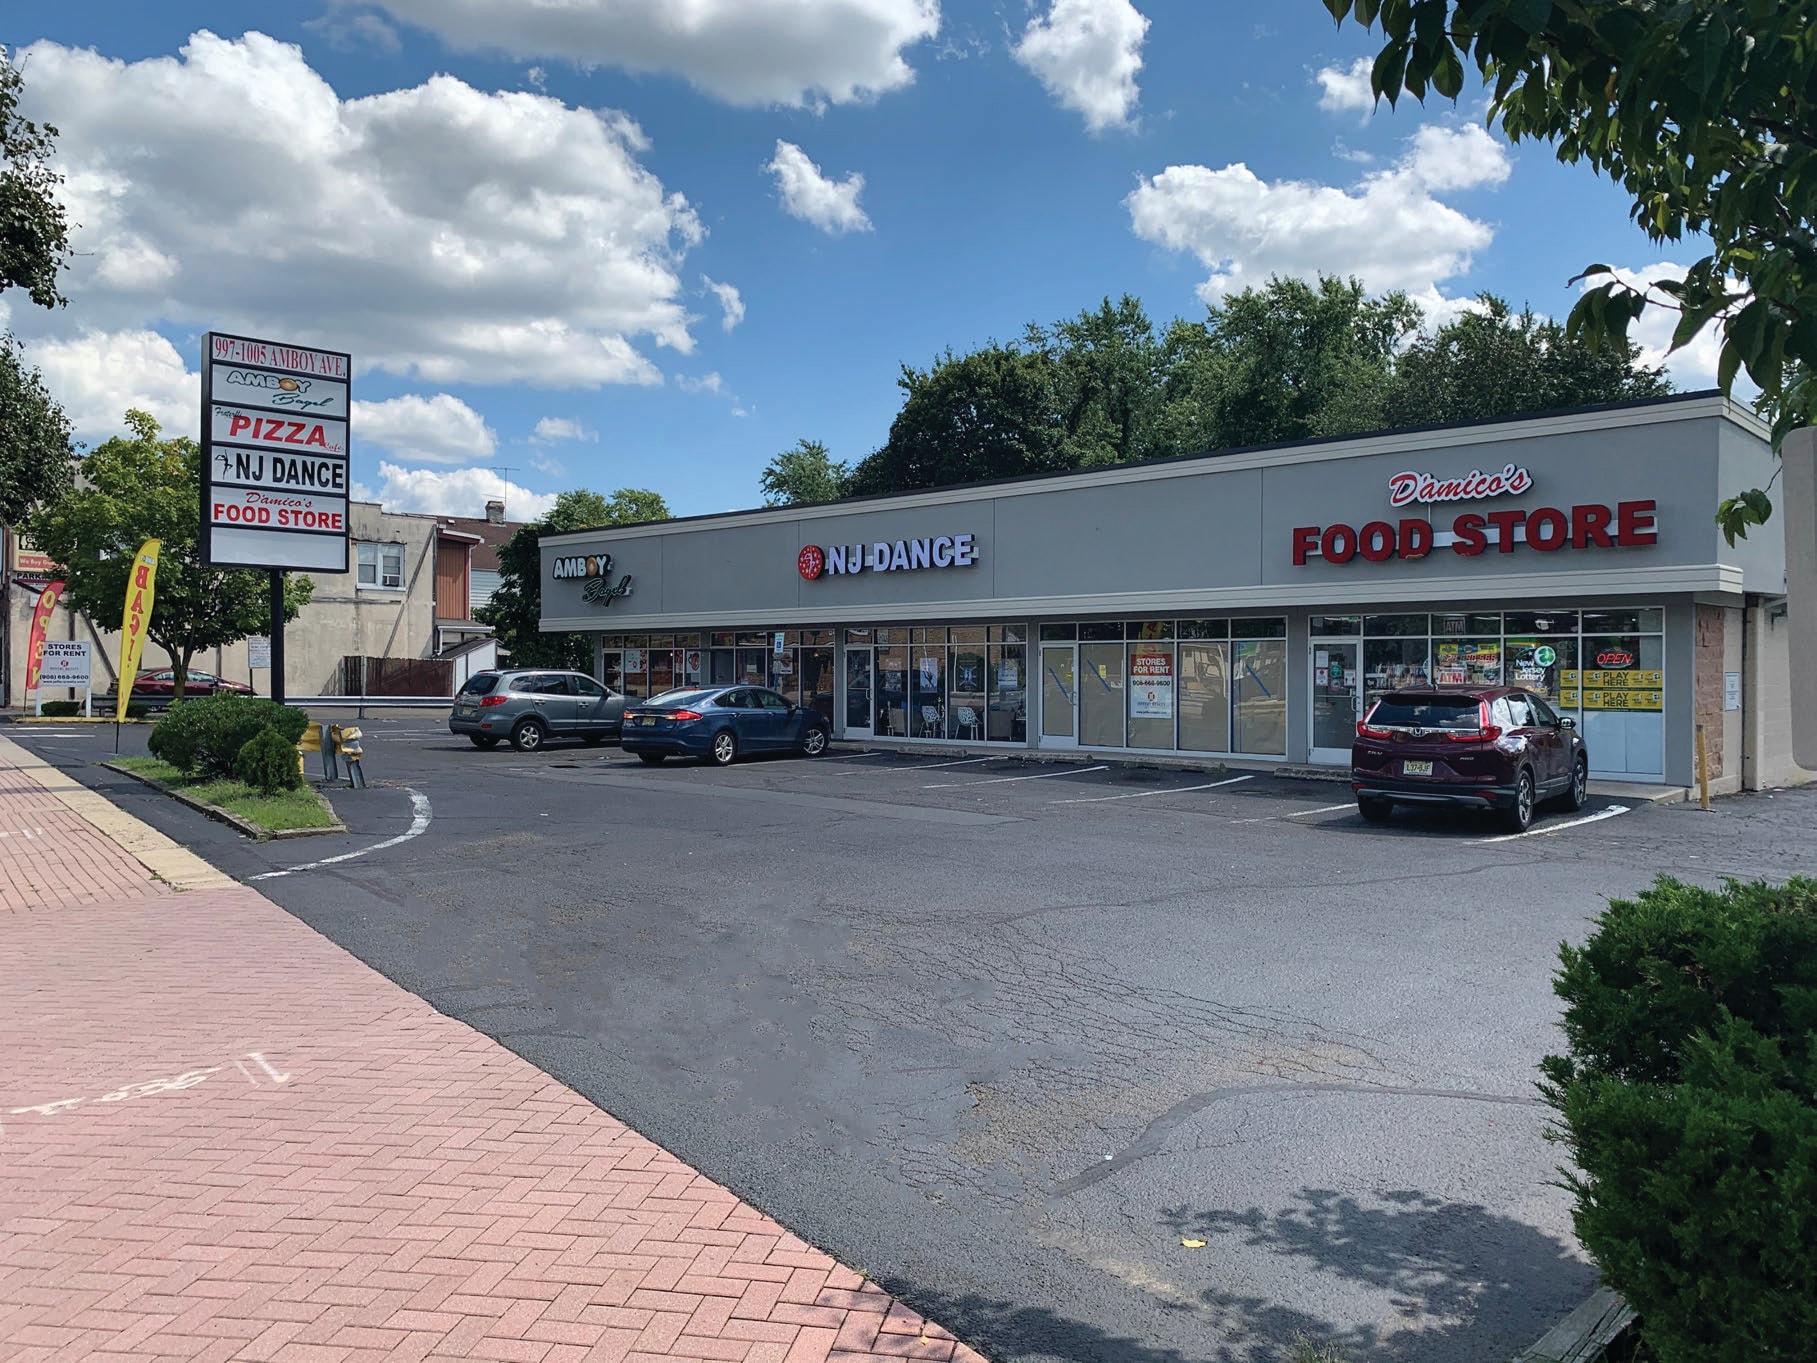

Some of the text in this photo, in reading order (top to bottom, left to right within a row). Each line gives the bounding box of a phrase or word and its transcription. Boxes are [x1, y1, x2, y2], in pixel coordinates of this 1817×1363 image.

[215, 338, 346, 377] 997-1005 AMBOY AVE.
[226, 370, 312, 393] AMBOY
[272, 393, 334, 410] Bagel
[229, 416, 326, 447] PIZZA
[236, 453, 344, 489] NJ DANCE
[1389, 464, 1533, 507] D'amico's
[213, 503, 343, 530] FOOD STORE
[1292, 500, 1657, 566] FOOD STORE
[829, 534, 973, 575] NJ DANCE
[553, 555, 610, 579] AMBOY
[583, 575, 631, 607] Bagel
[1446, 621, 1464, 634] ATM
[1136, 658, 1166, 666] STORES
[1515, 659, 1534, 667] New
[1597, 653, 1633, 664] OPEN
[1440, 671, 1464, 683] ATM
[1515, 673, 1546, 681] Lottery
[1521, 667, 1546, 675] Jersey
[1603, 671, 1629, 679] PLAY
[1603, 692, 1629, 700] PLAY
